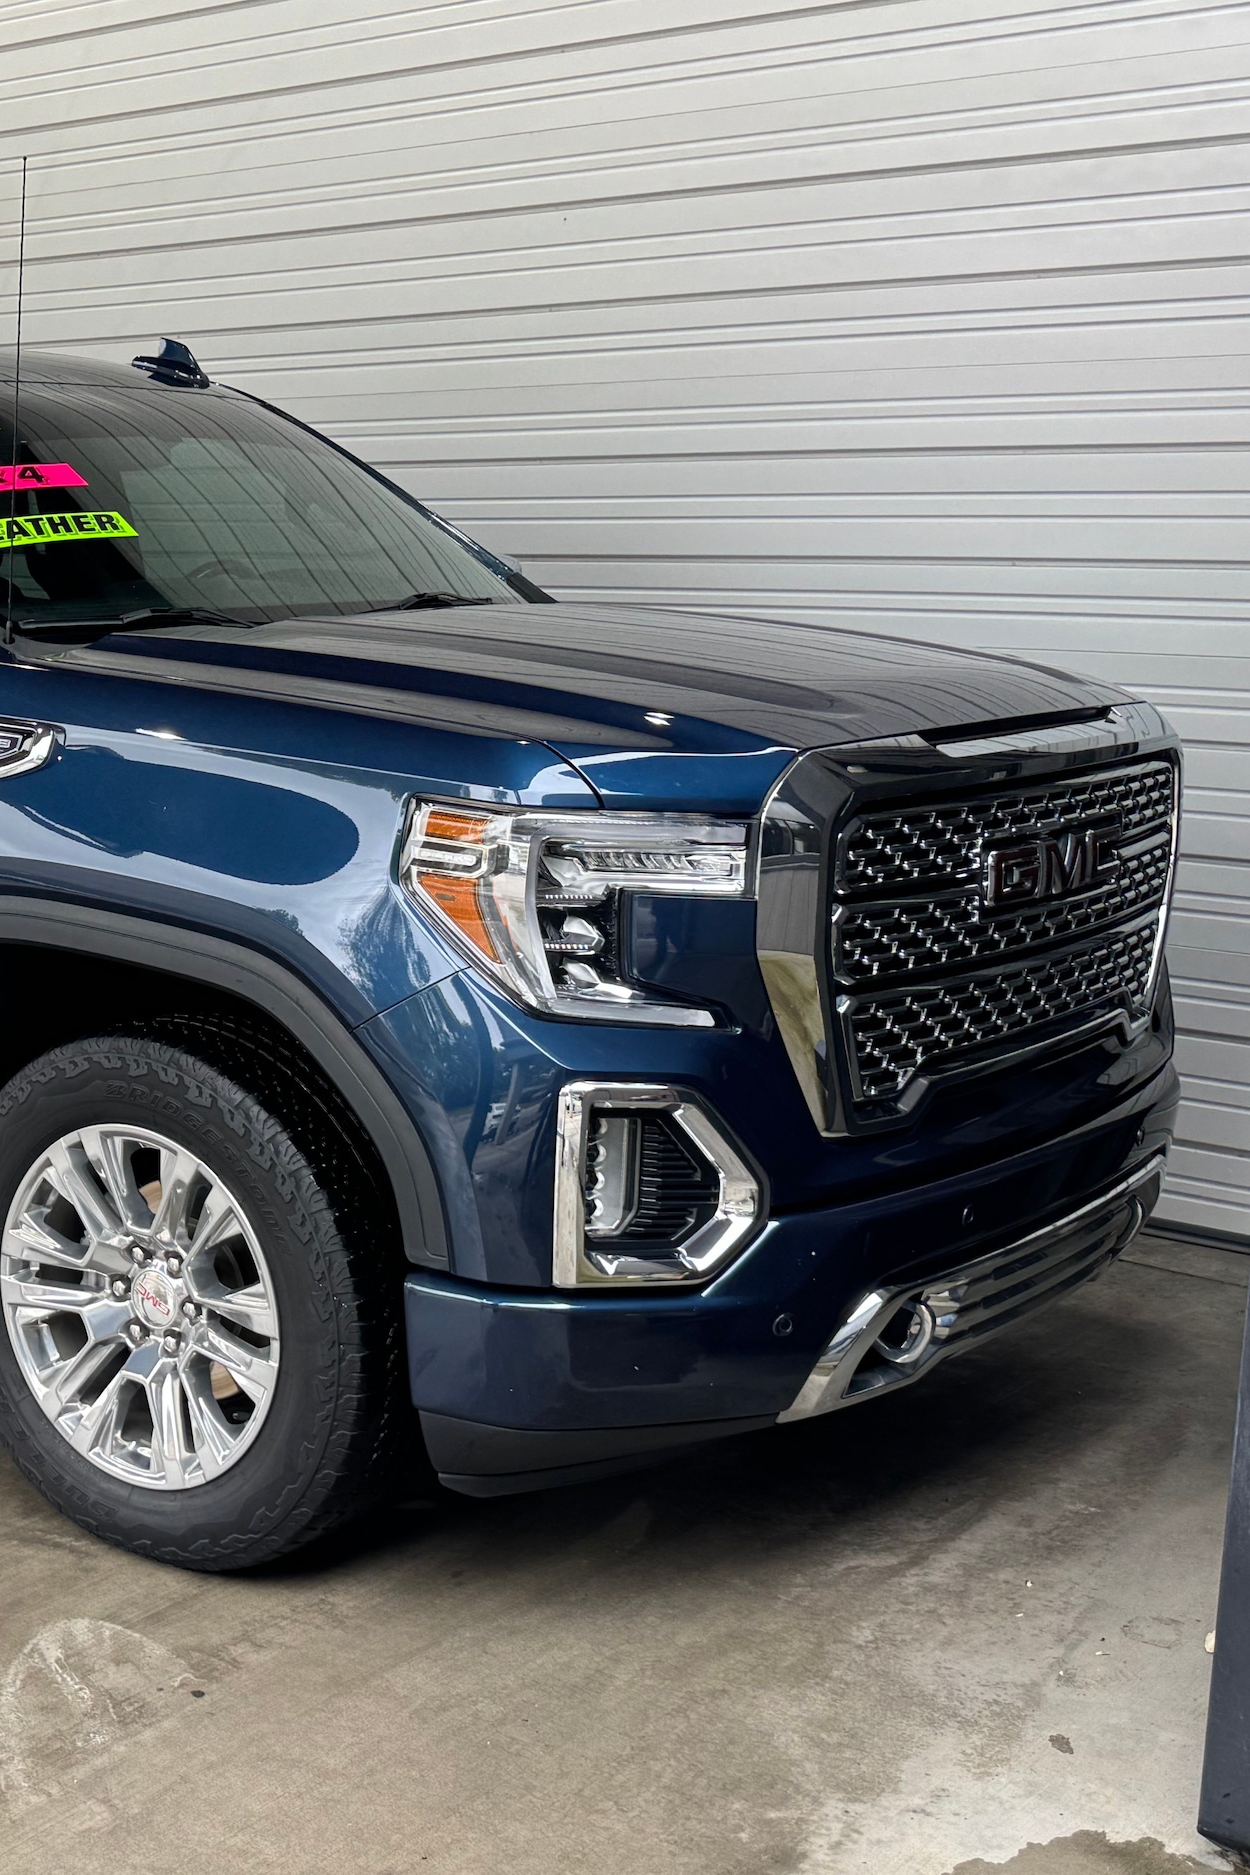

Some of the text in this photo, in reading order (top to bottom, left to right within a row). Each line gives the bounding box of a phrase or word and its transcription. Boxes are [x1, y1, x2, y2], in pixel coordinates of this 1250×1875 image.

[985, 823, 1122, 906] GMC
[103, 1079, 293, 1256] BRIDGESTONE
[134, 1281, 171, 1317] GMC
